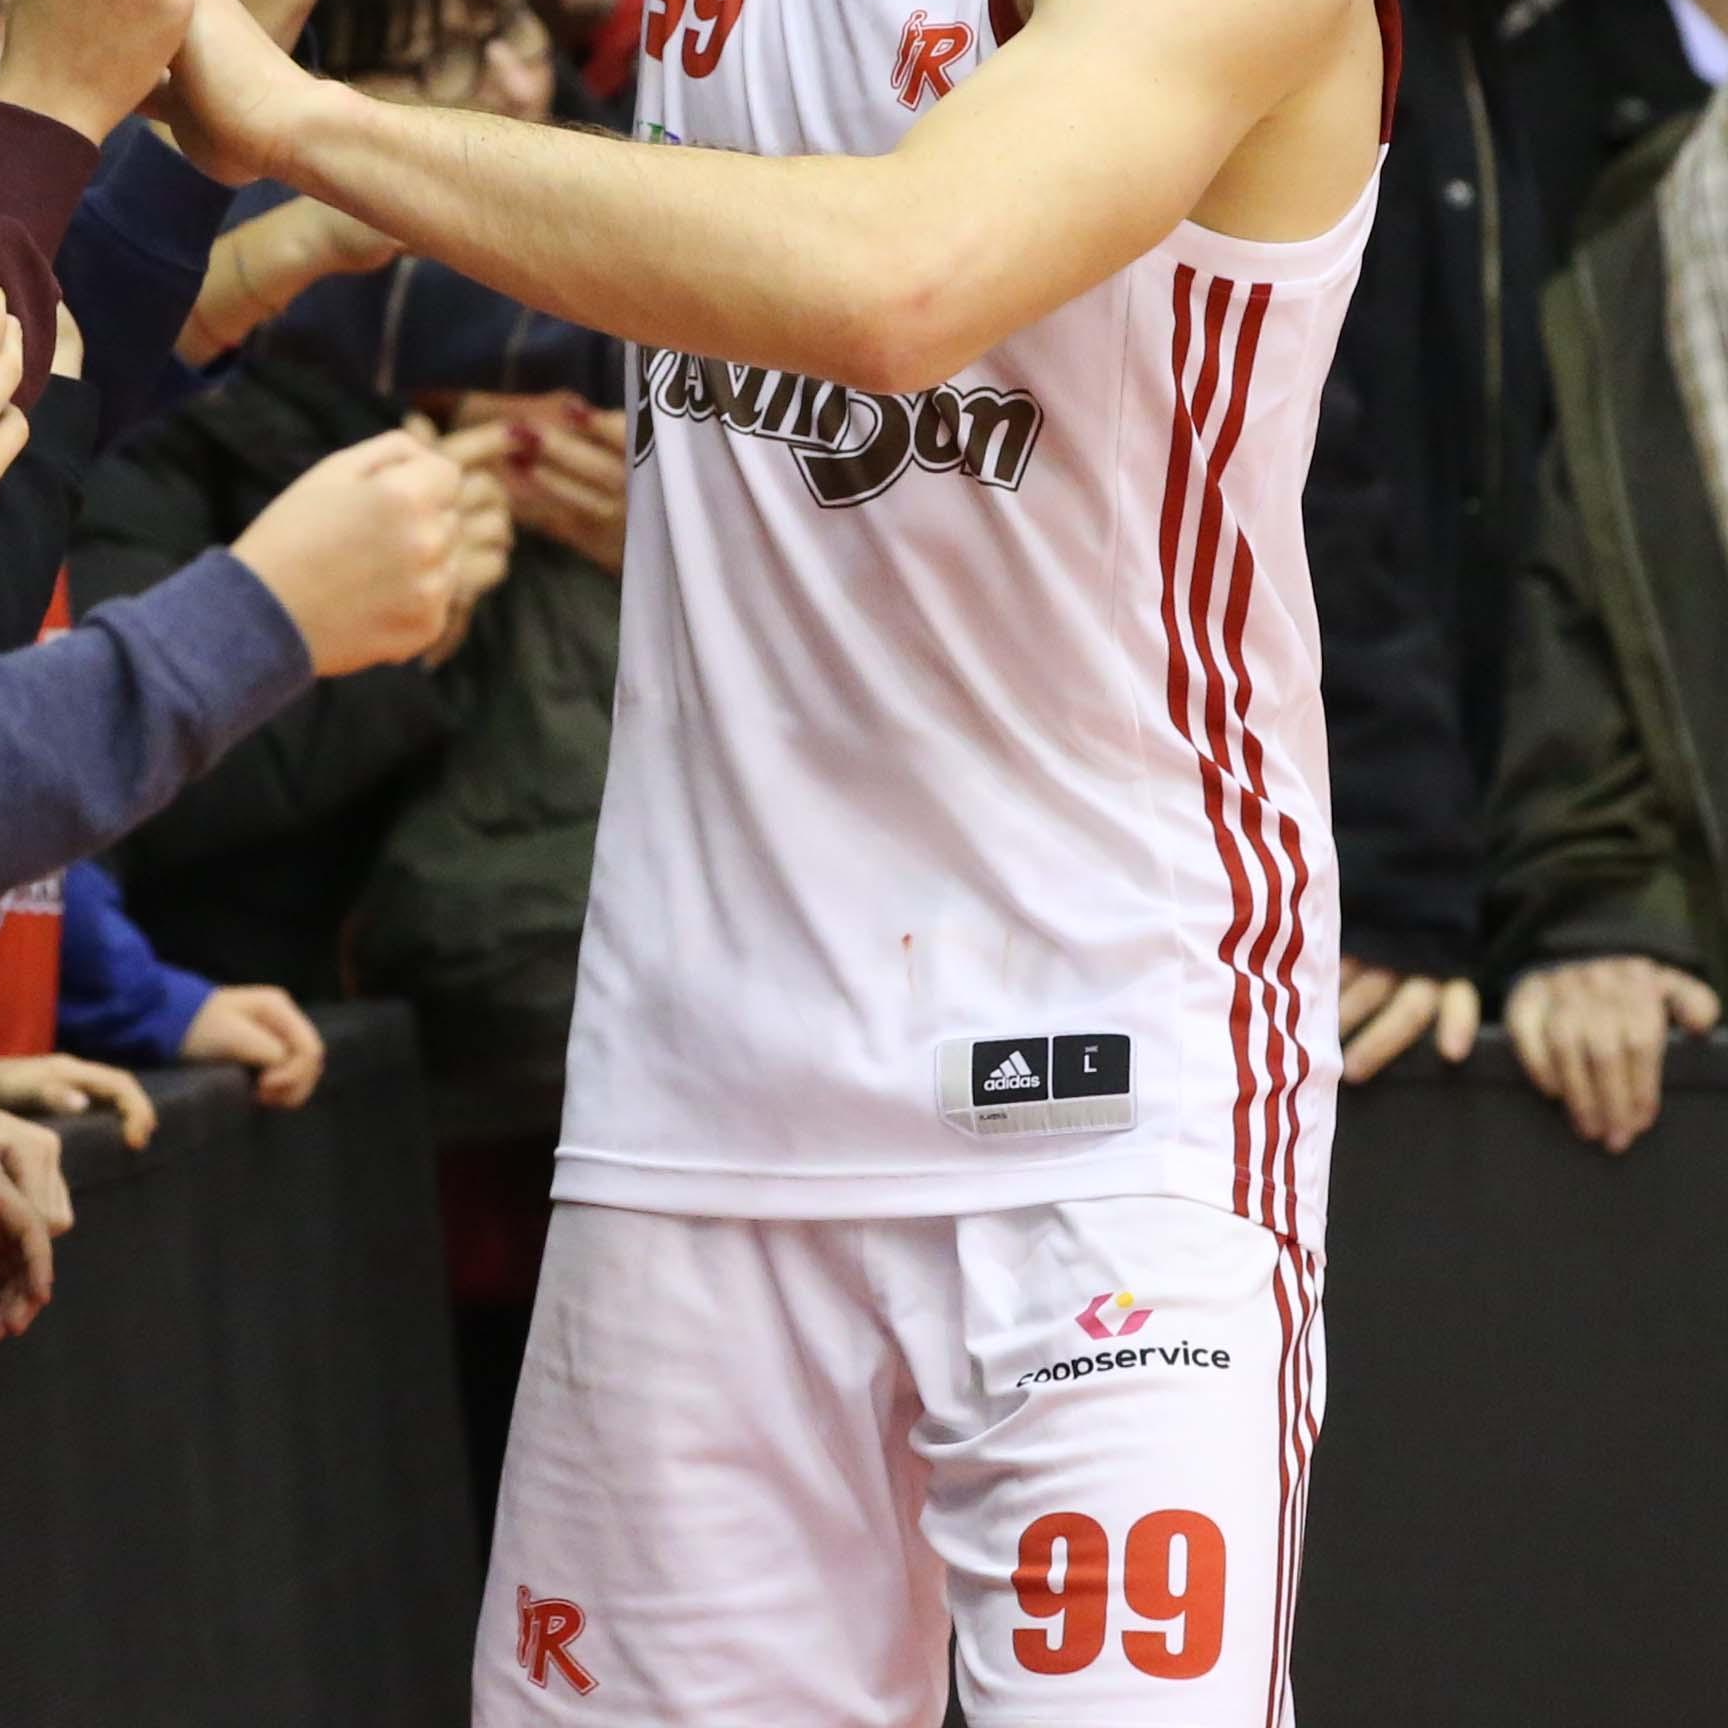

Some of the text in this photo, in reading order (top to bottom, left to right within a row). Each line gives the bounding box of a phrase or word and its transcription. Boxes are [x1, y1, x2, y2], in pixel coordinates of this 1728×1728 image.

[1083, 1054, 1097, 1073] L
[983, 1075, 1040, 1091] adidas
[1011, 1509, 1227, 1680] 99
